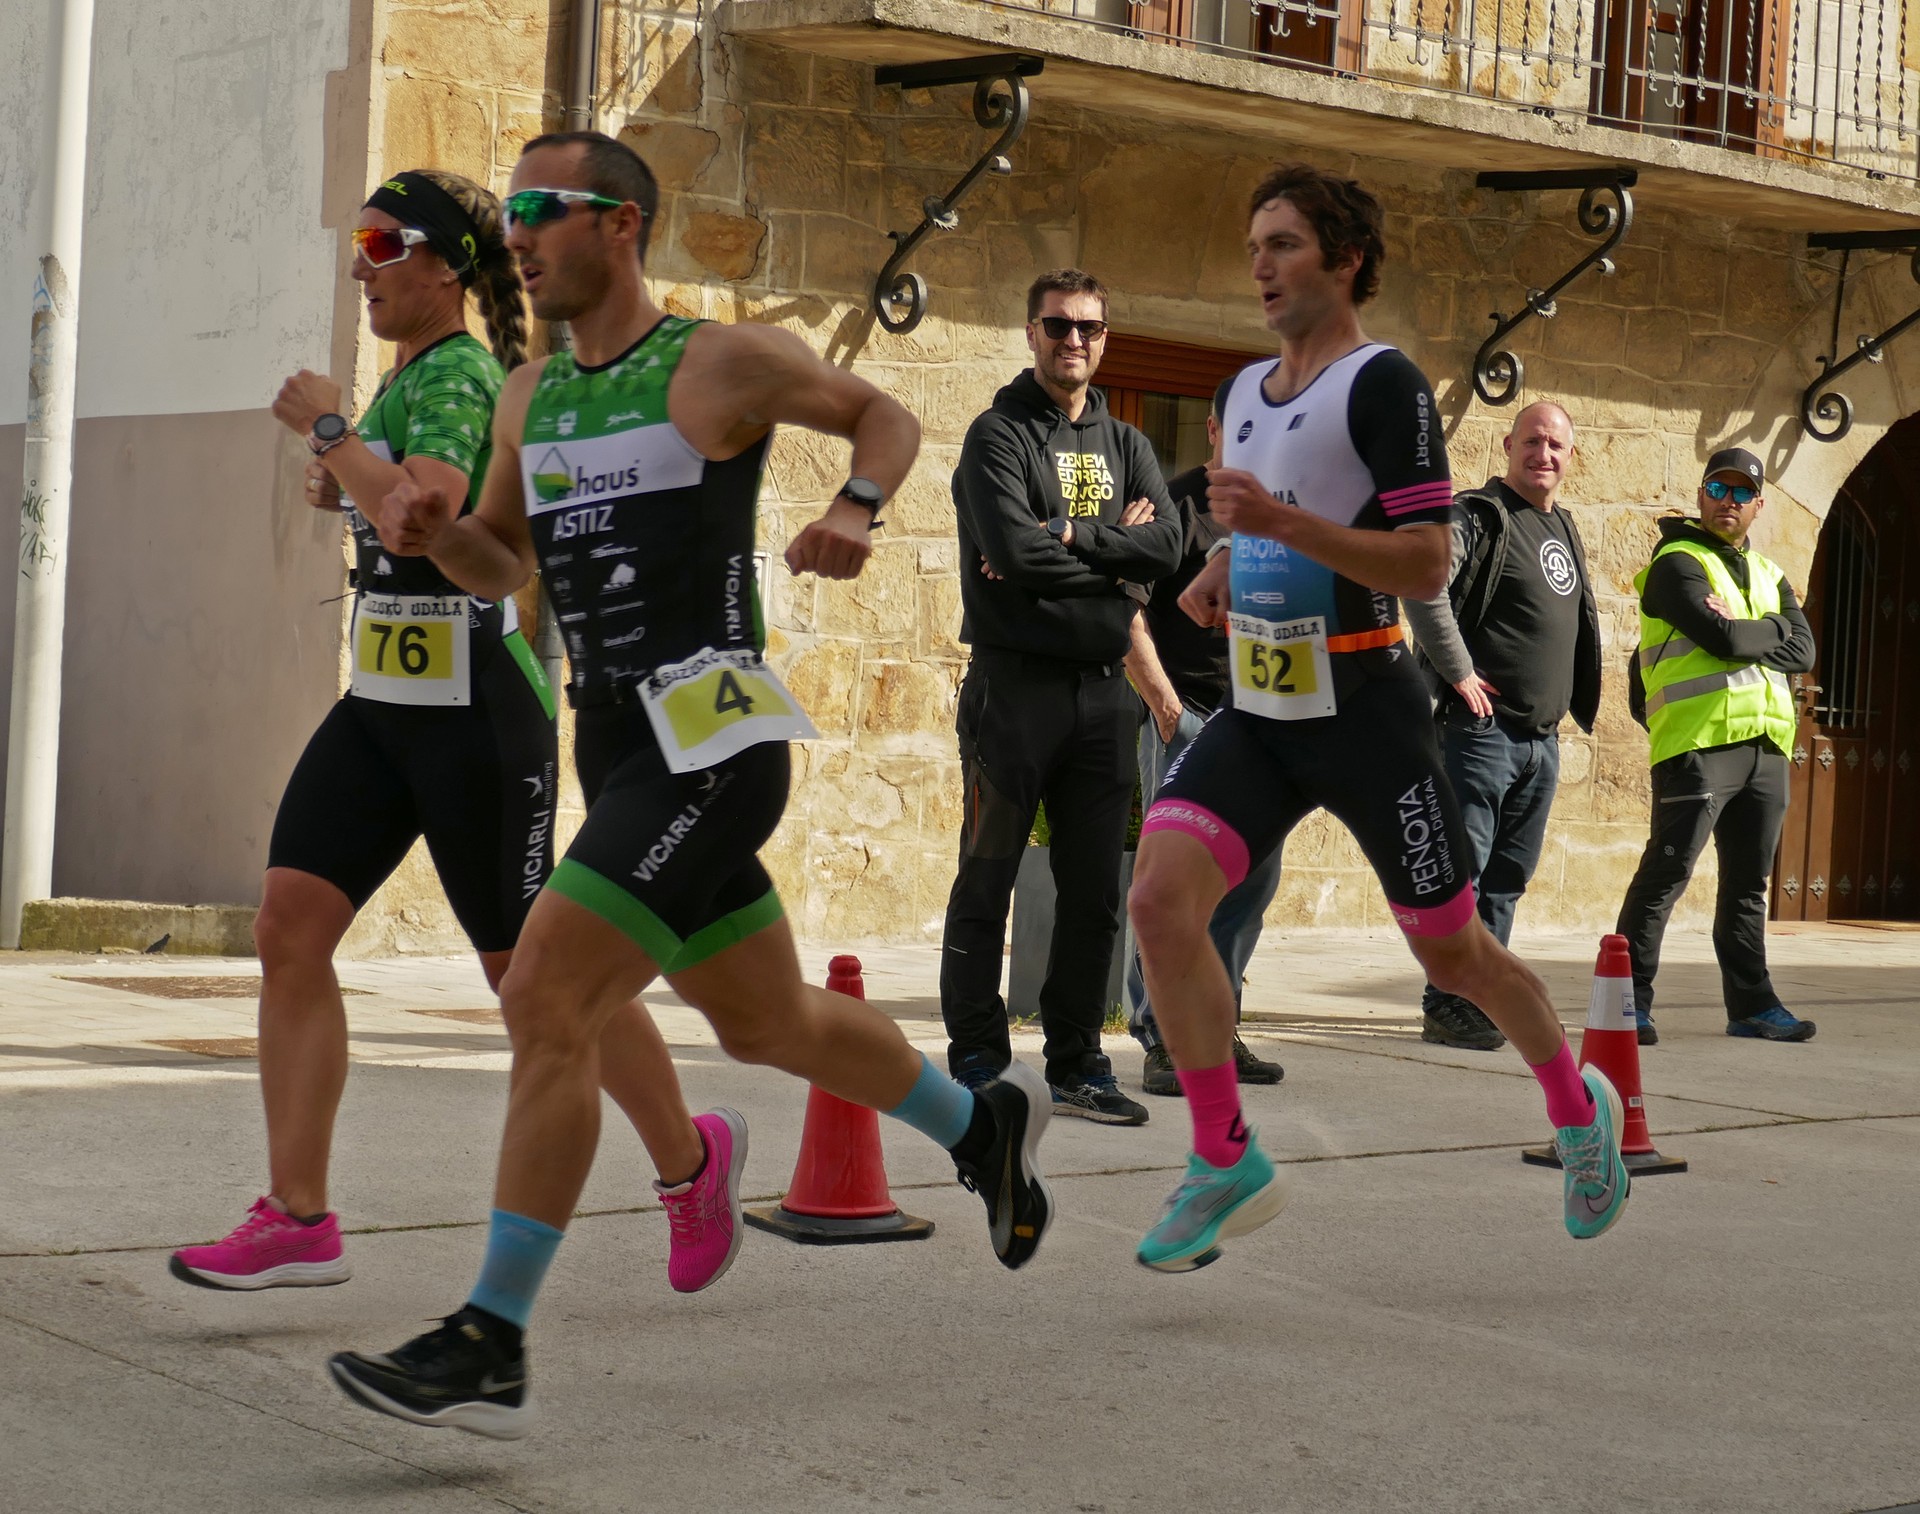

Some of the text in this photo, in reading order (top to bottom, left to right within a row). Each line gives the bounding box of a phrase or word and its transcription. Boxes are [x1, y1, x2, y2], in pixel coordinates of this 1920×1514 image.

[552, 505, 615, 542] ASTIZ
[1068, 500, 1100, 517] DEN
[411, 601, 463, 617] UDALA
[1273, 621, 1321, 641] UDALA
[370, 623, 429, 676] 76
[1251, 643, 1296, 694] 52
[714, 670, 755, 715] 4
[1423, 775, 1444, 832] DENTAL
[522, 810, 551, 900] VICARLI
[631, 803, 702, 882] VICARLI
[1396, 783, 1442, 896] PEÑOTA
